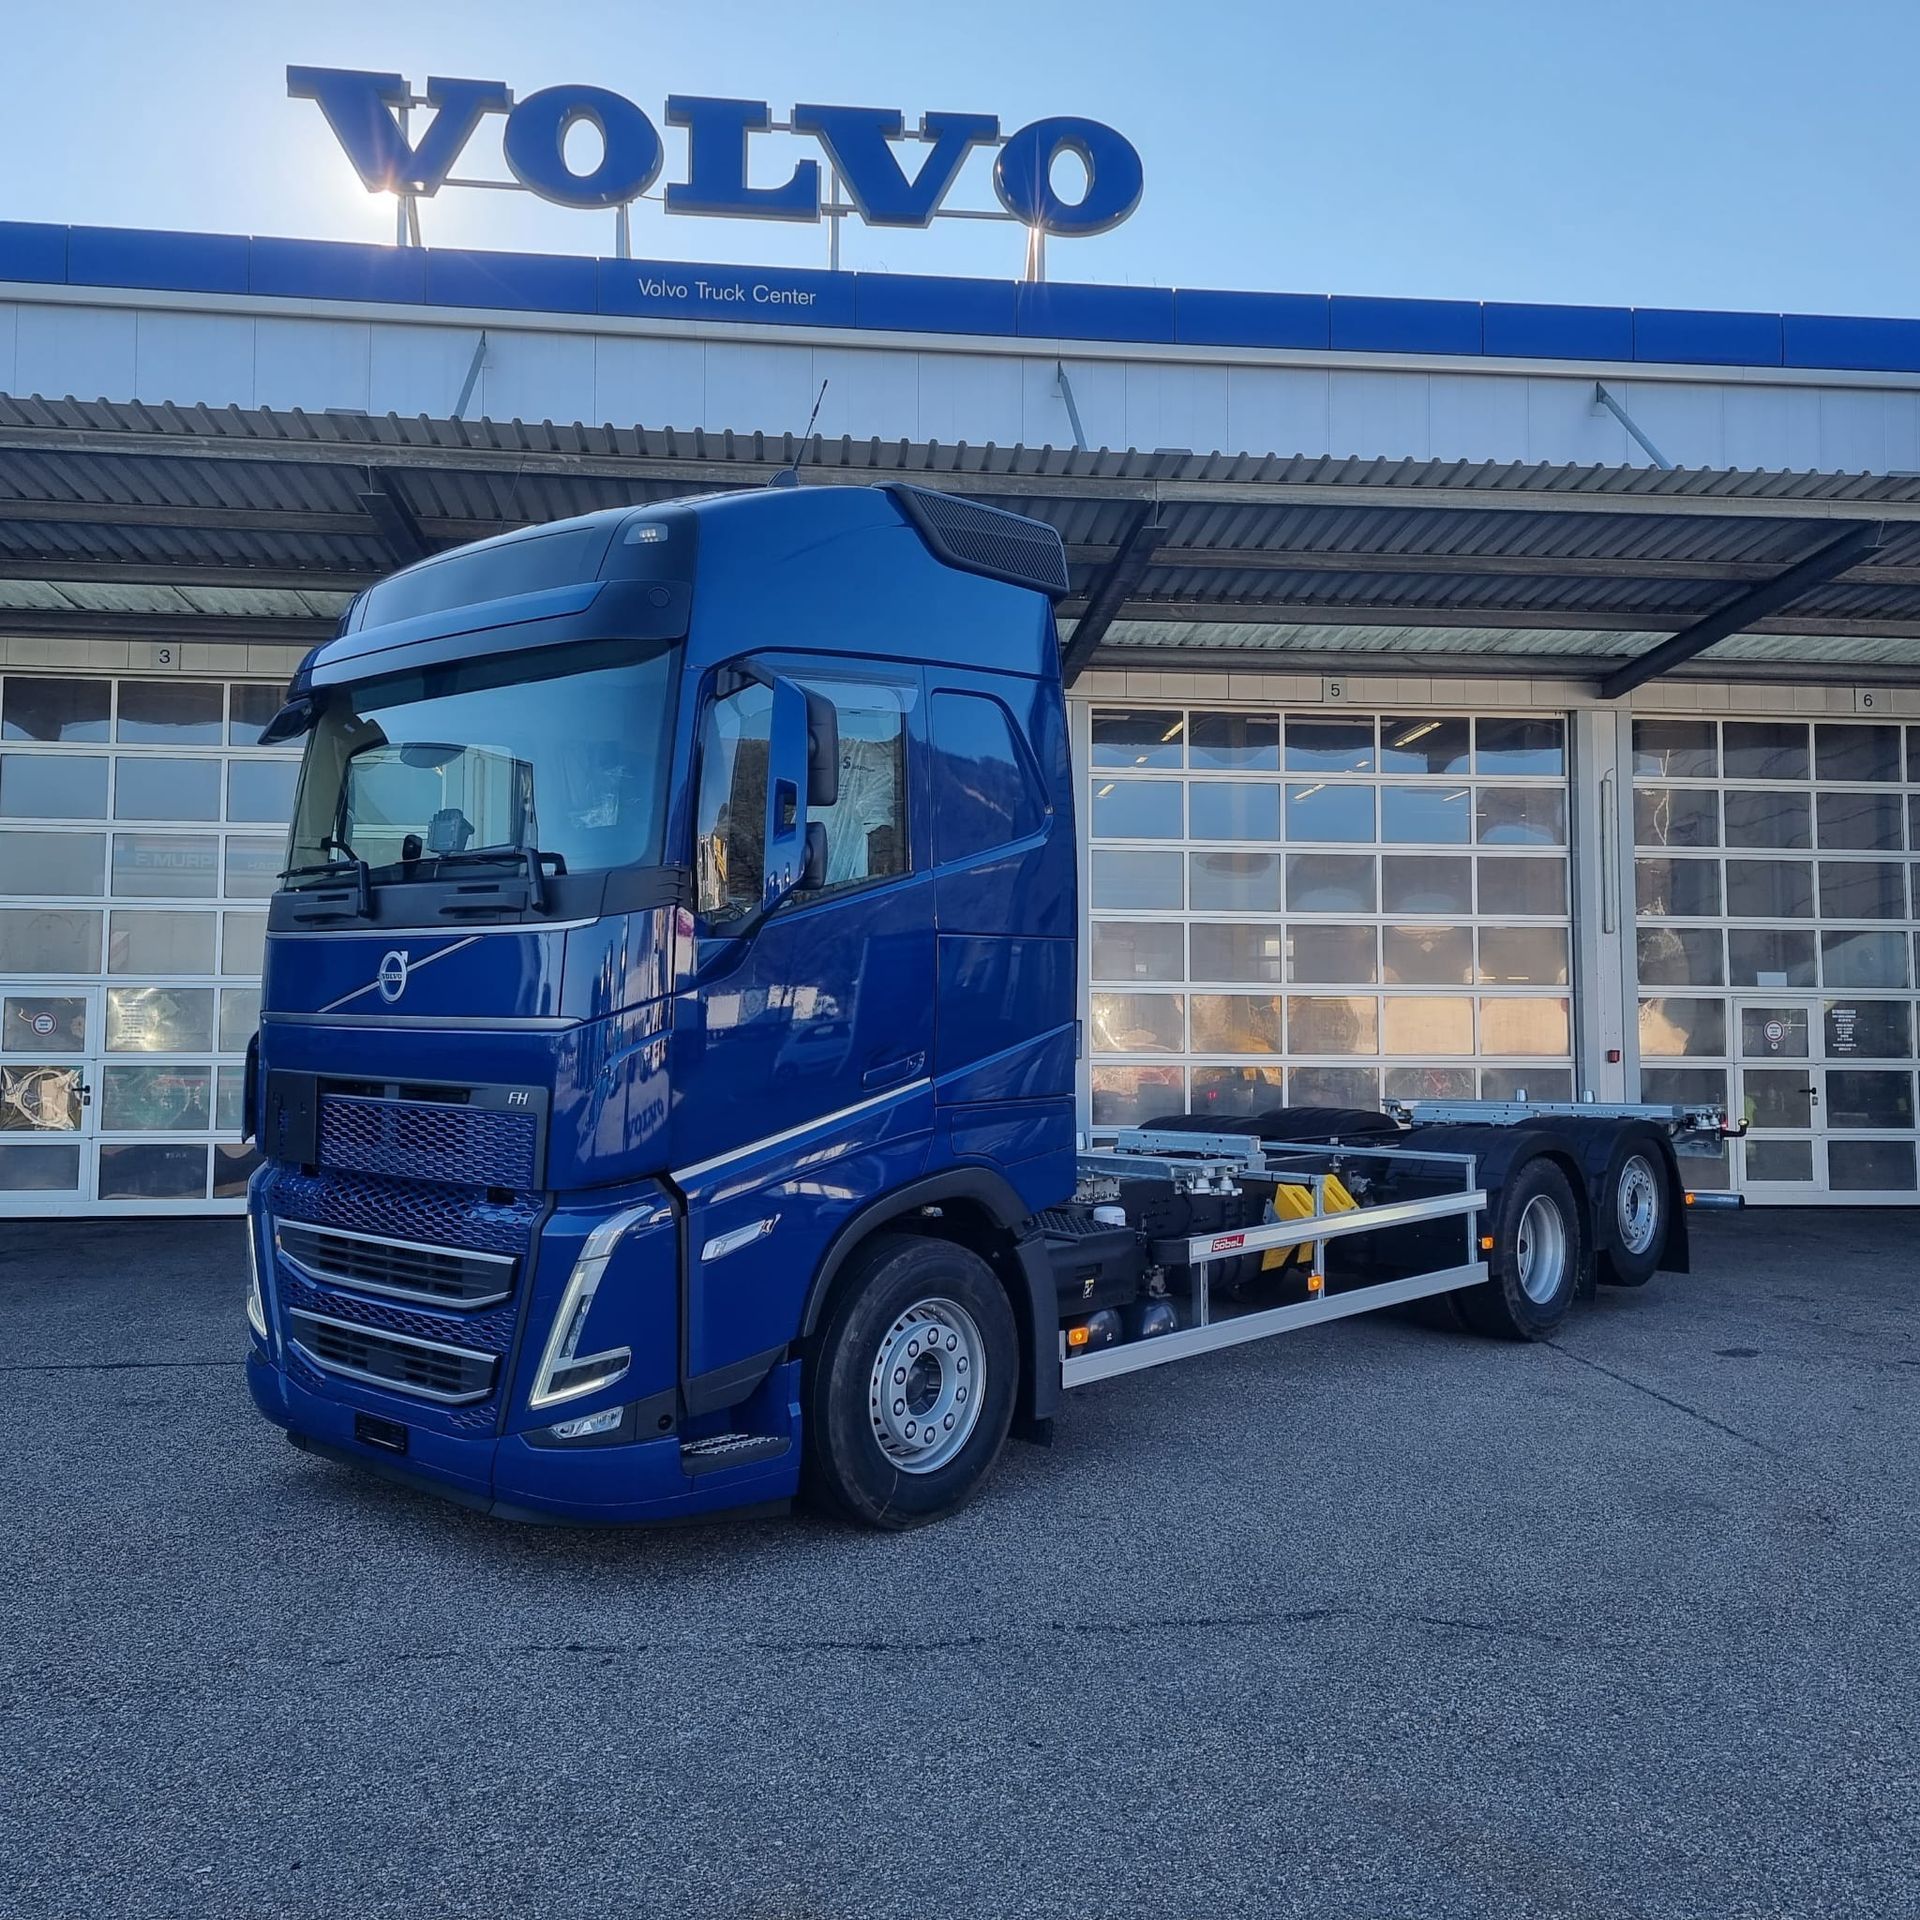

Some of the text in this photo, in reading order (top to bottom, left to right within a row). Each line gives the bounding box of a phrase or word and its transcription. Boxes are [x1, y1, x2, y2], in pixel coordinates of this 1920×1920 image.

[287, 65, 1143, 237] VOLVO
[638, 278, 817, 305] Volvo Truck Center
[159, 649, 170, 664] 3
[1331, 683, 1341, 697] 5
[1863, 693, 1873, 707] 6
[507, 1091, 529, 1105] FH
